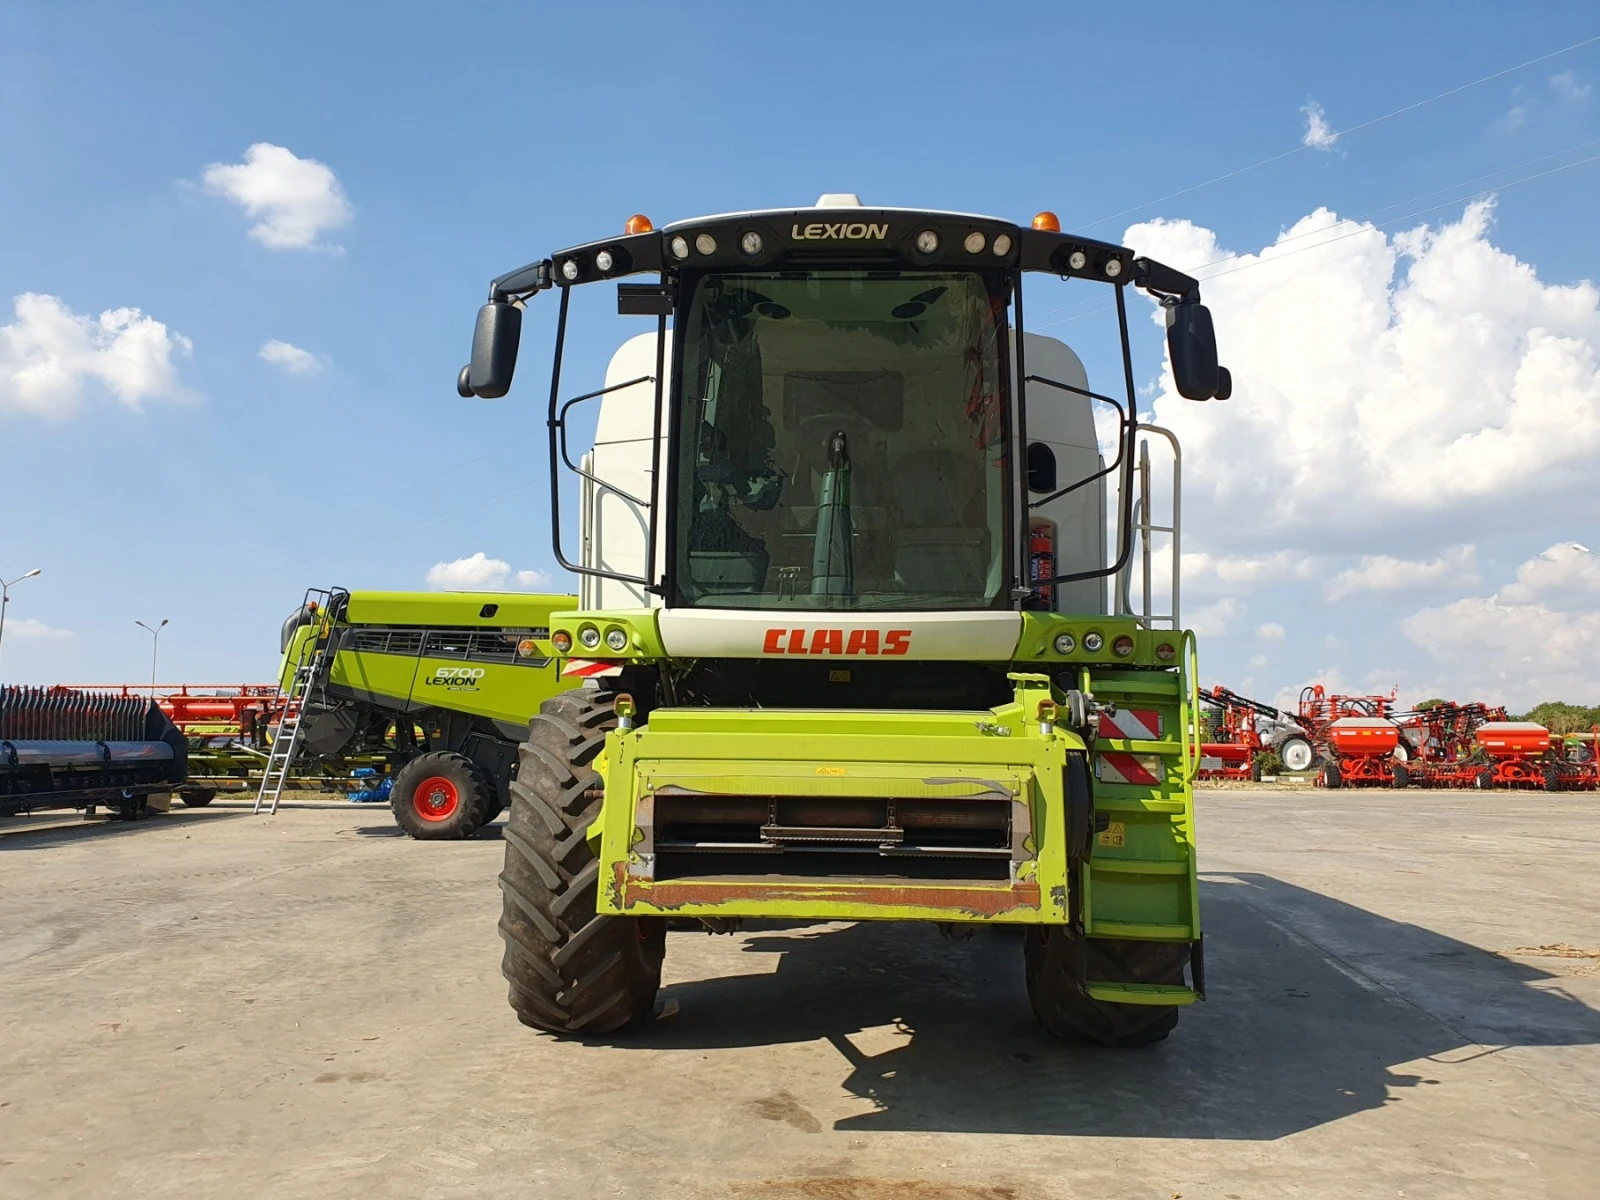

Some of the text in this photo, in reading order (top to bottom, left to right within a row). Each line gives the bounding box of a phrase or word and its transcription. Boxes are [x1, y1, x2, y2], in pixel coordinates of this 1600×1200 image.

[791, 223, 889, 240] LEXION
[763, 629, 912, 655] CLAAS
[436, 667, 485, 678] 6700
[425, 677, 476, 686] LEXION
